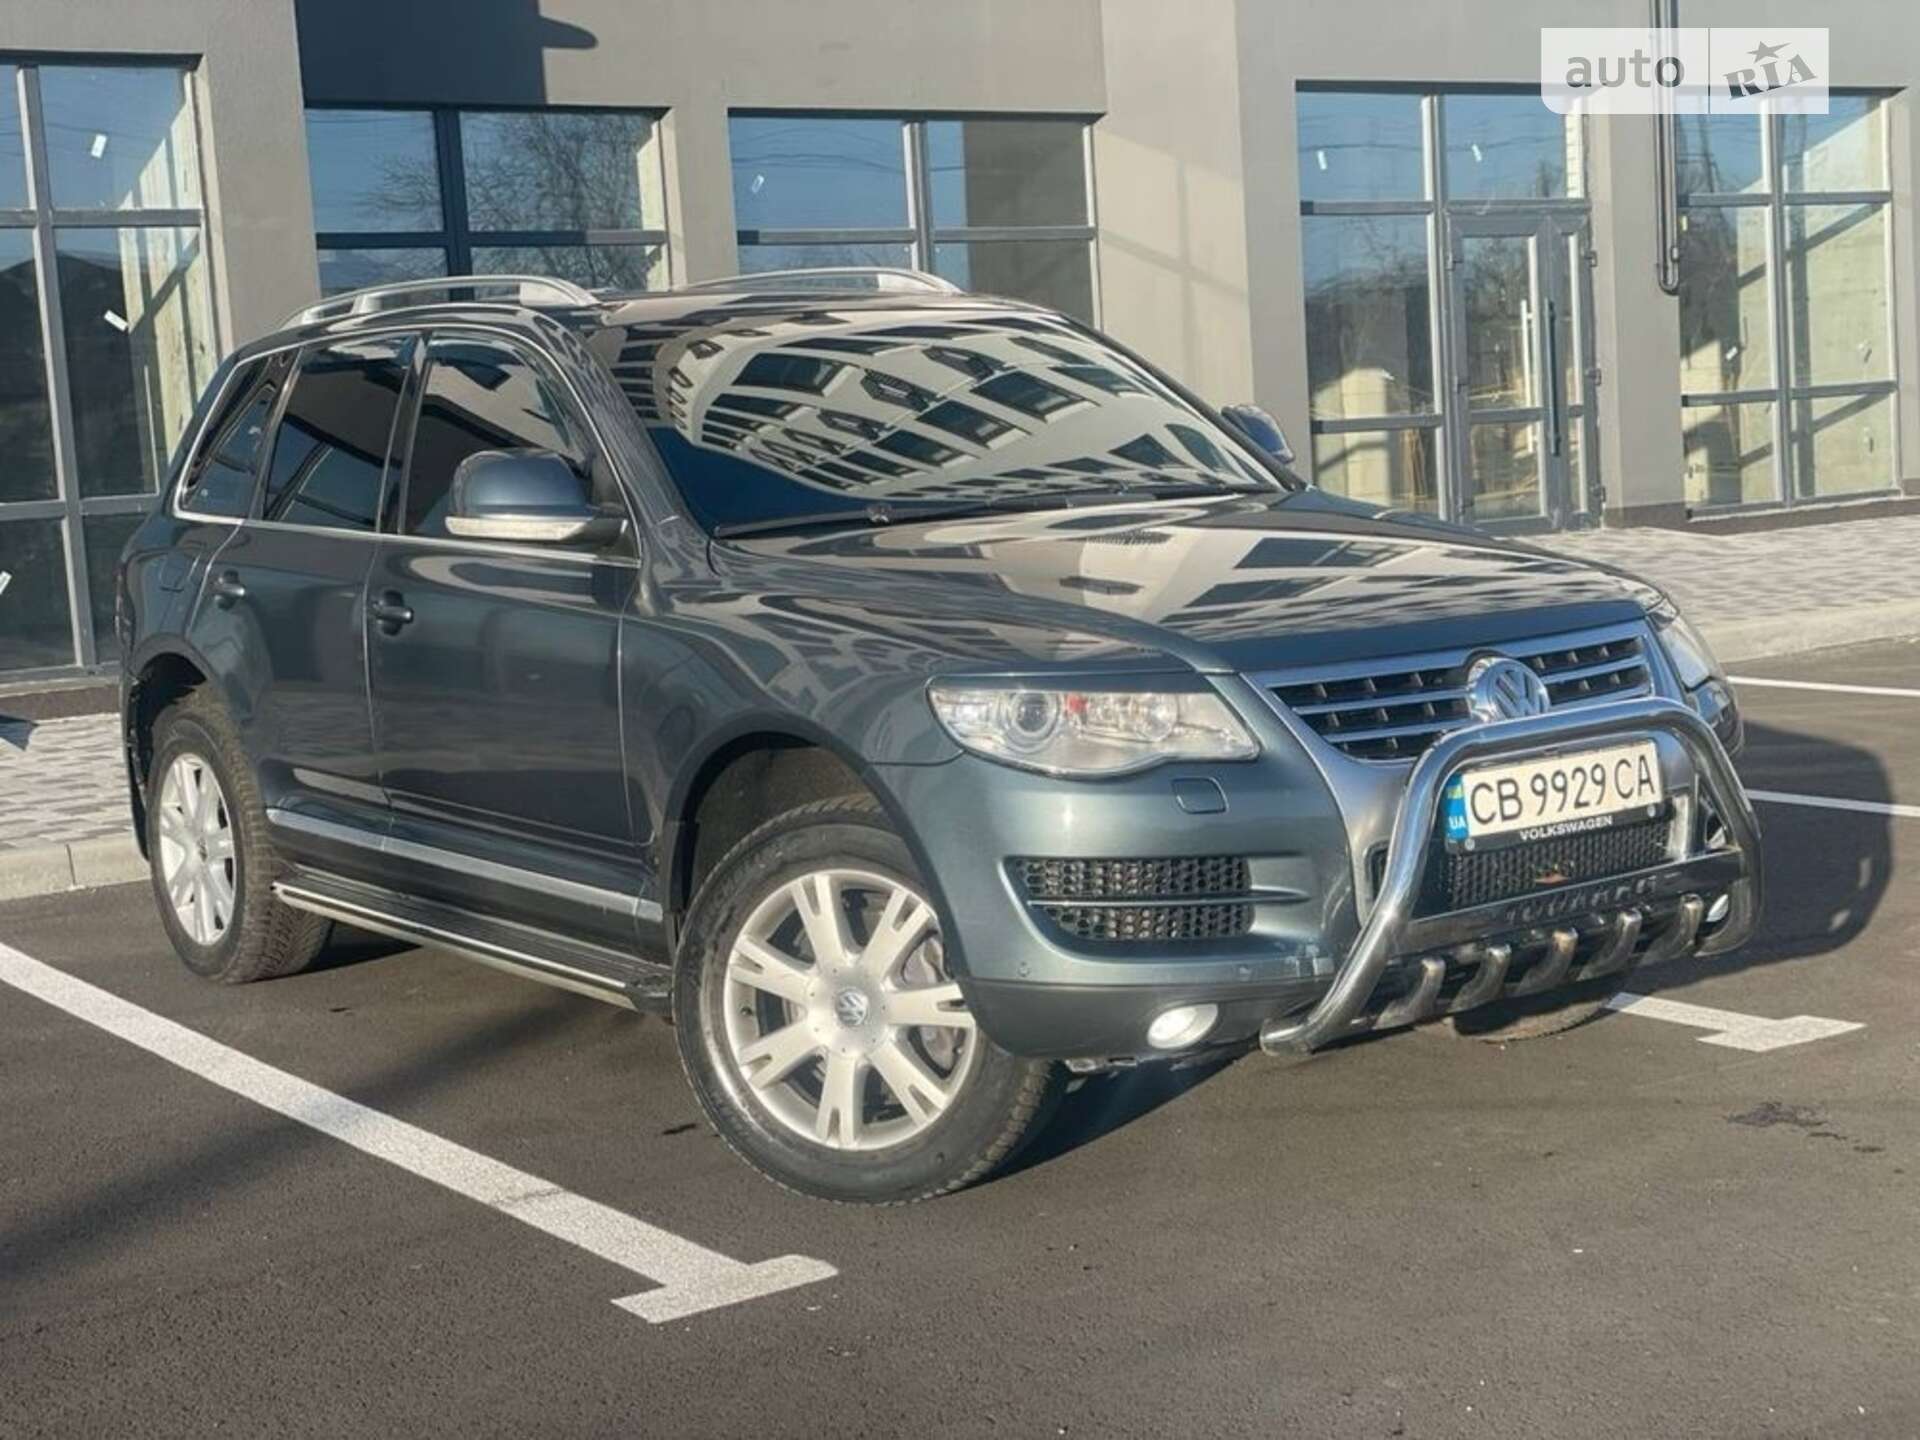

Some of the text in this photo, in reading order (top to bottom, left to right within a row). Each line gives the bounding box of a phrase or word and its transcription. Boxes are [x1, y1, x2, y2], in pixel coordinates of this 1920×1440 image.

[1470, 755, 1655, 825] CB 9929 CA
[1449, 815, 1466, 830] UA
[1519, 814, 1613, 841] VOLKSWAGEN
